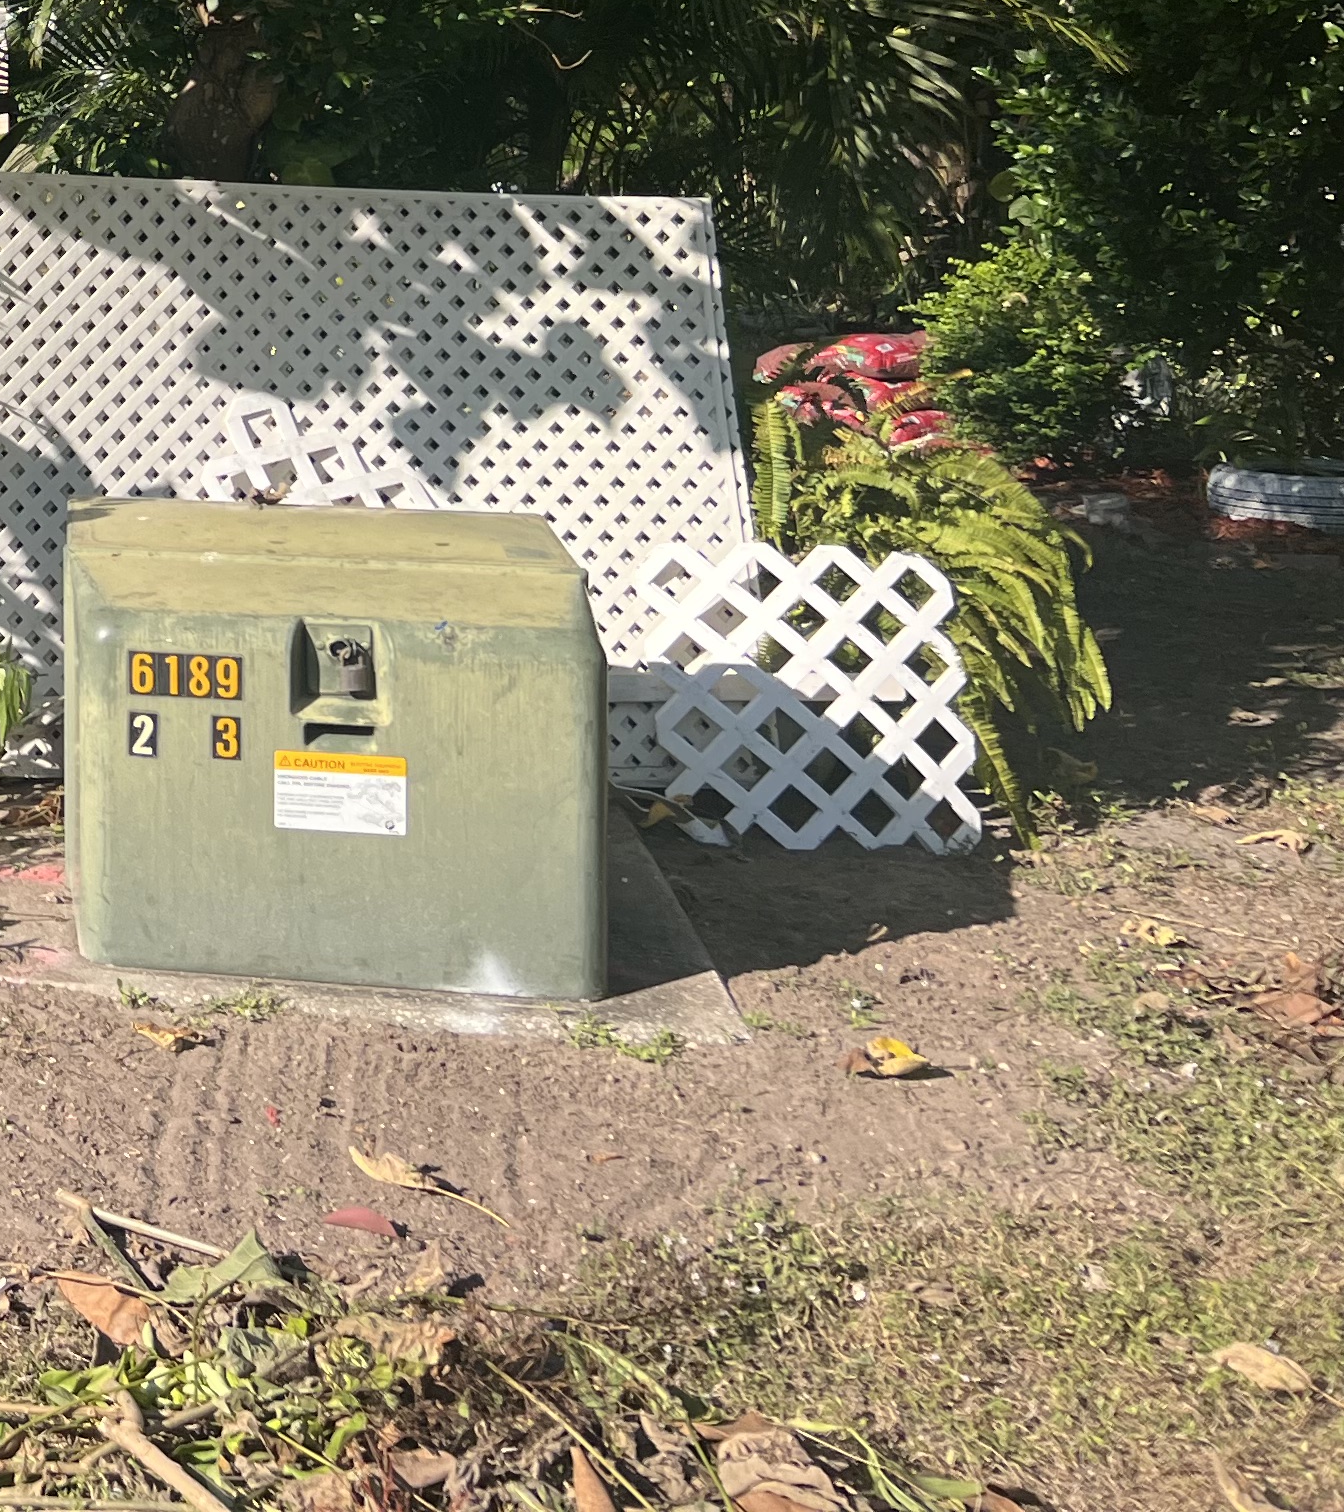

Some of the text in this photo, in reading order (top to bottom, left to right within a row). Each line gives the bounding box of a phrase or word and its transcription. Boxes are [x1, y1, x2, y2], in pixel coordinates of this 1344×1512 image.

[132, 653, 239, 698] 6189
[132, 714, 238, 758] 2 3
[294, 758, 345, 770] CAUTION
